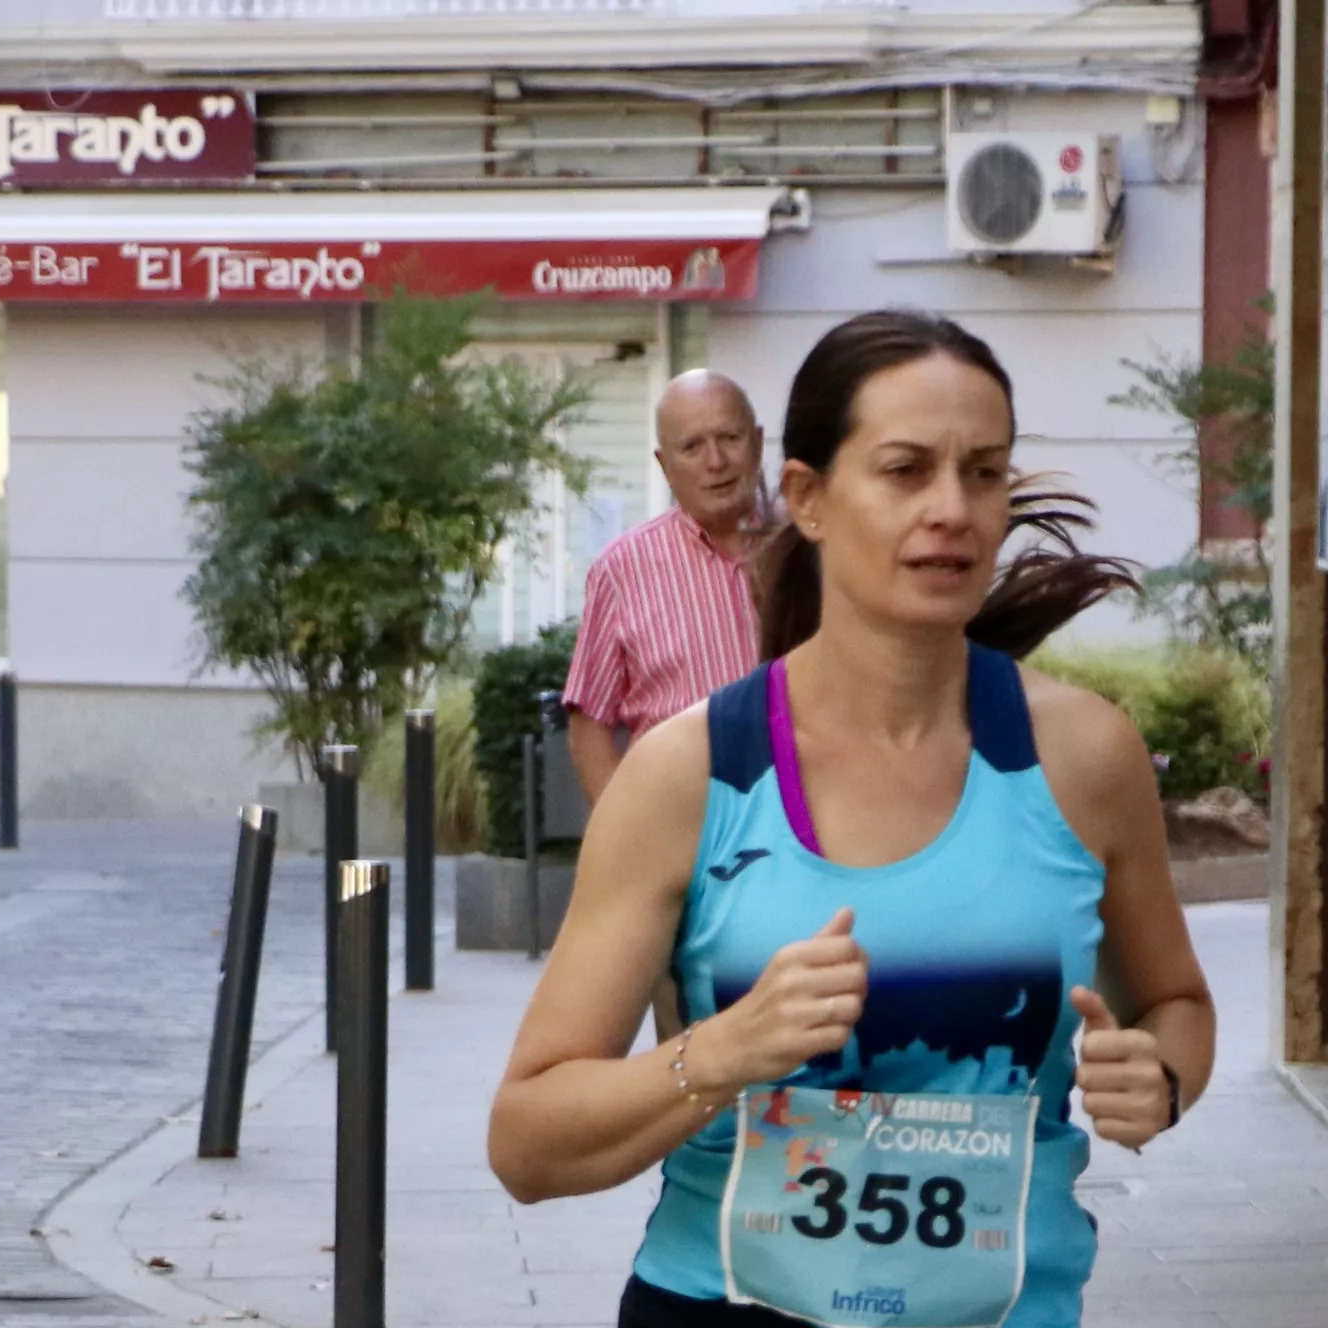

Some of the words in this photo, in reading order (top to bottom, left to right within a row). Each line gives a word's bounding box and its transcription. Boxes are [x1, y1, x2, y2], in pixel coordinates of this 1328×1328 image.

[532, 258, 673, 295] Cruzcampo
[893, 1099, 973, 1123] CARRERA
[791, 1167, 967, 1249] 358
[832, 1288, 906, 1315] Infrico
